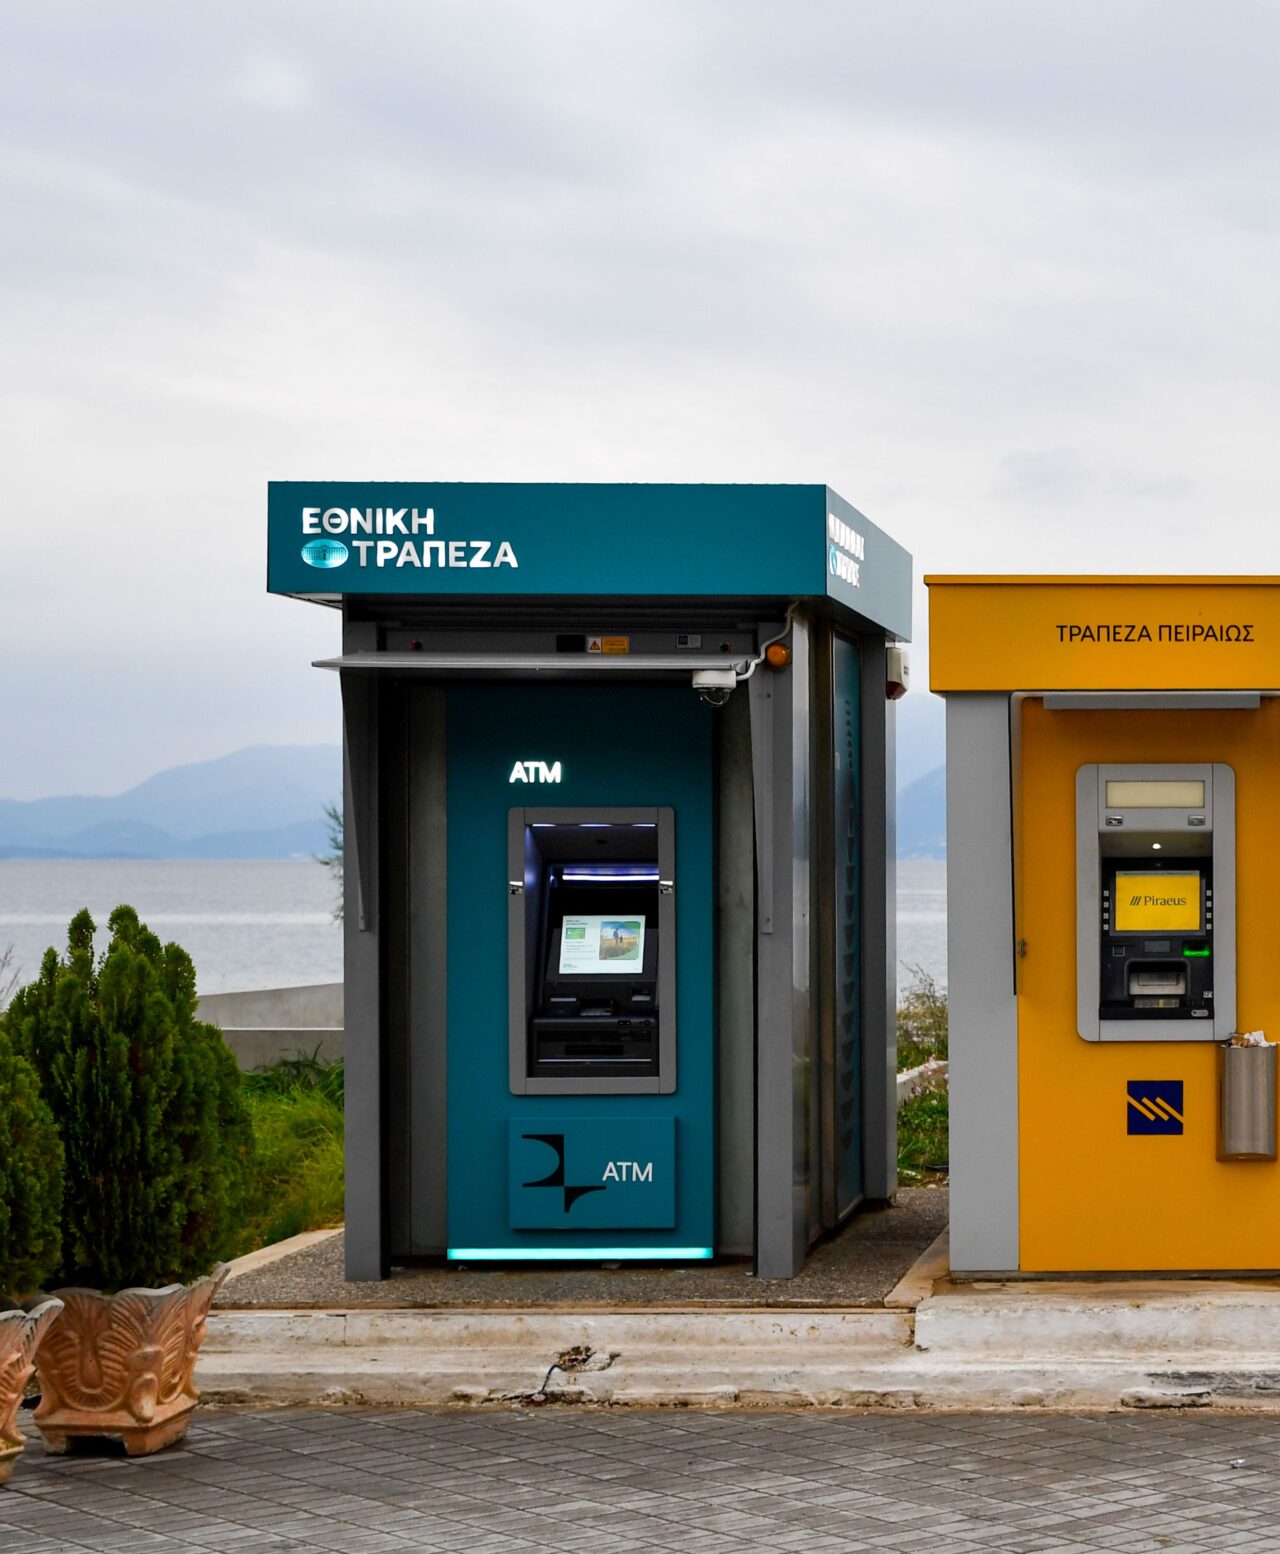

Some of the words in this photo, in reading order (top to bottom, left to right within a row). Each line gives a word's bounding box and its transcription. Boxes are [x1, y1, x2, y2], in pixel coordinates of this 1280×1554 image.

[302, 507, 435, 535] ΕΘΝΙΚΗ
[352, 540, 519, 568] ΤΡΑΠΕΖΑ
[1056, 624, 1153, 643] ΤΡΑΠΕΖΑ
[1158, 624, 1255, 643] ΠΕΙΡΑΙΩΣ
[509, 760, 562, 784] ATM
[1144, 895, 1187, 906] Piraeus
[602, 1161, 653, 1182] ATM
